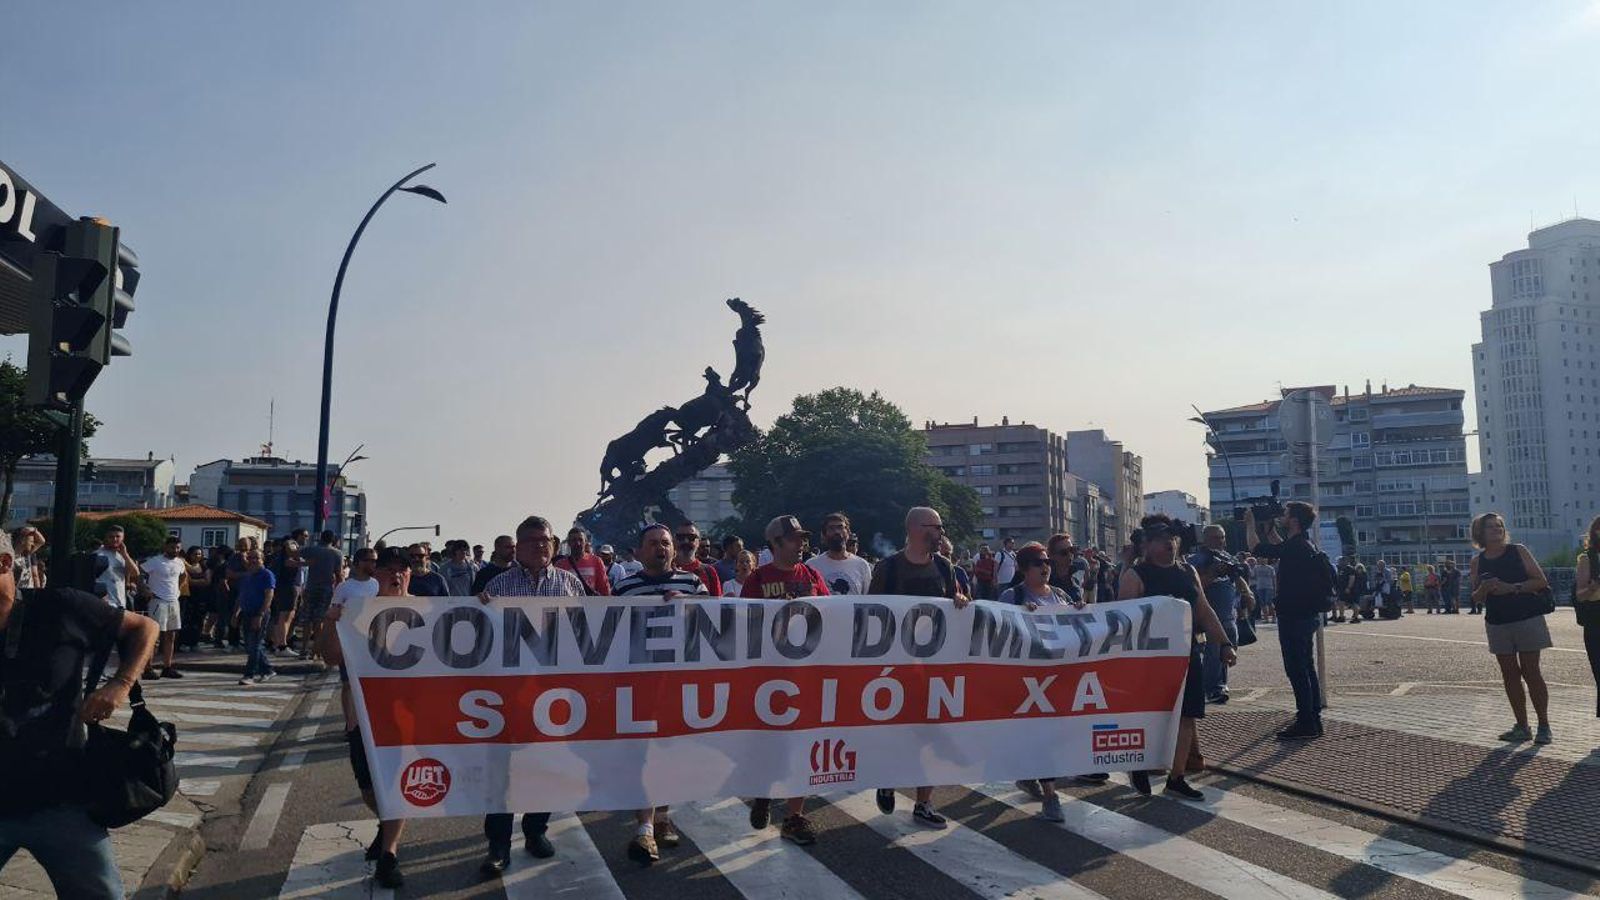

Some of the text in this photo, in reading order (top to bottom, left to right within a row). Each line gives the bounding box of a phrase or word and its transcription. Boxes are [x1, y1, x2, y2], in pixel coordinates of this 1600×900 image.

[368, 602, 1169, 670] CONVENIO DO METAL
[456, 666, 1109, 738] SOLUCIÓN XA
[1096, 733, 1141, 747] CCOO
[810, 738, 856, 772] CIG
[1093, 752, 1144, 765] industria
[408, 766, 445, 785] UGT
[810, 772, 855, 785] INDUSTRIA
